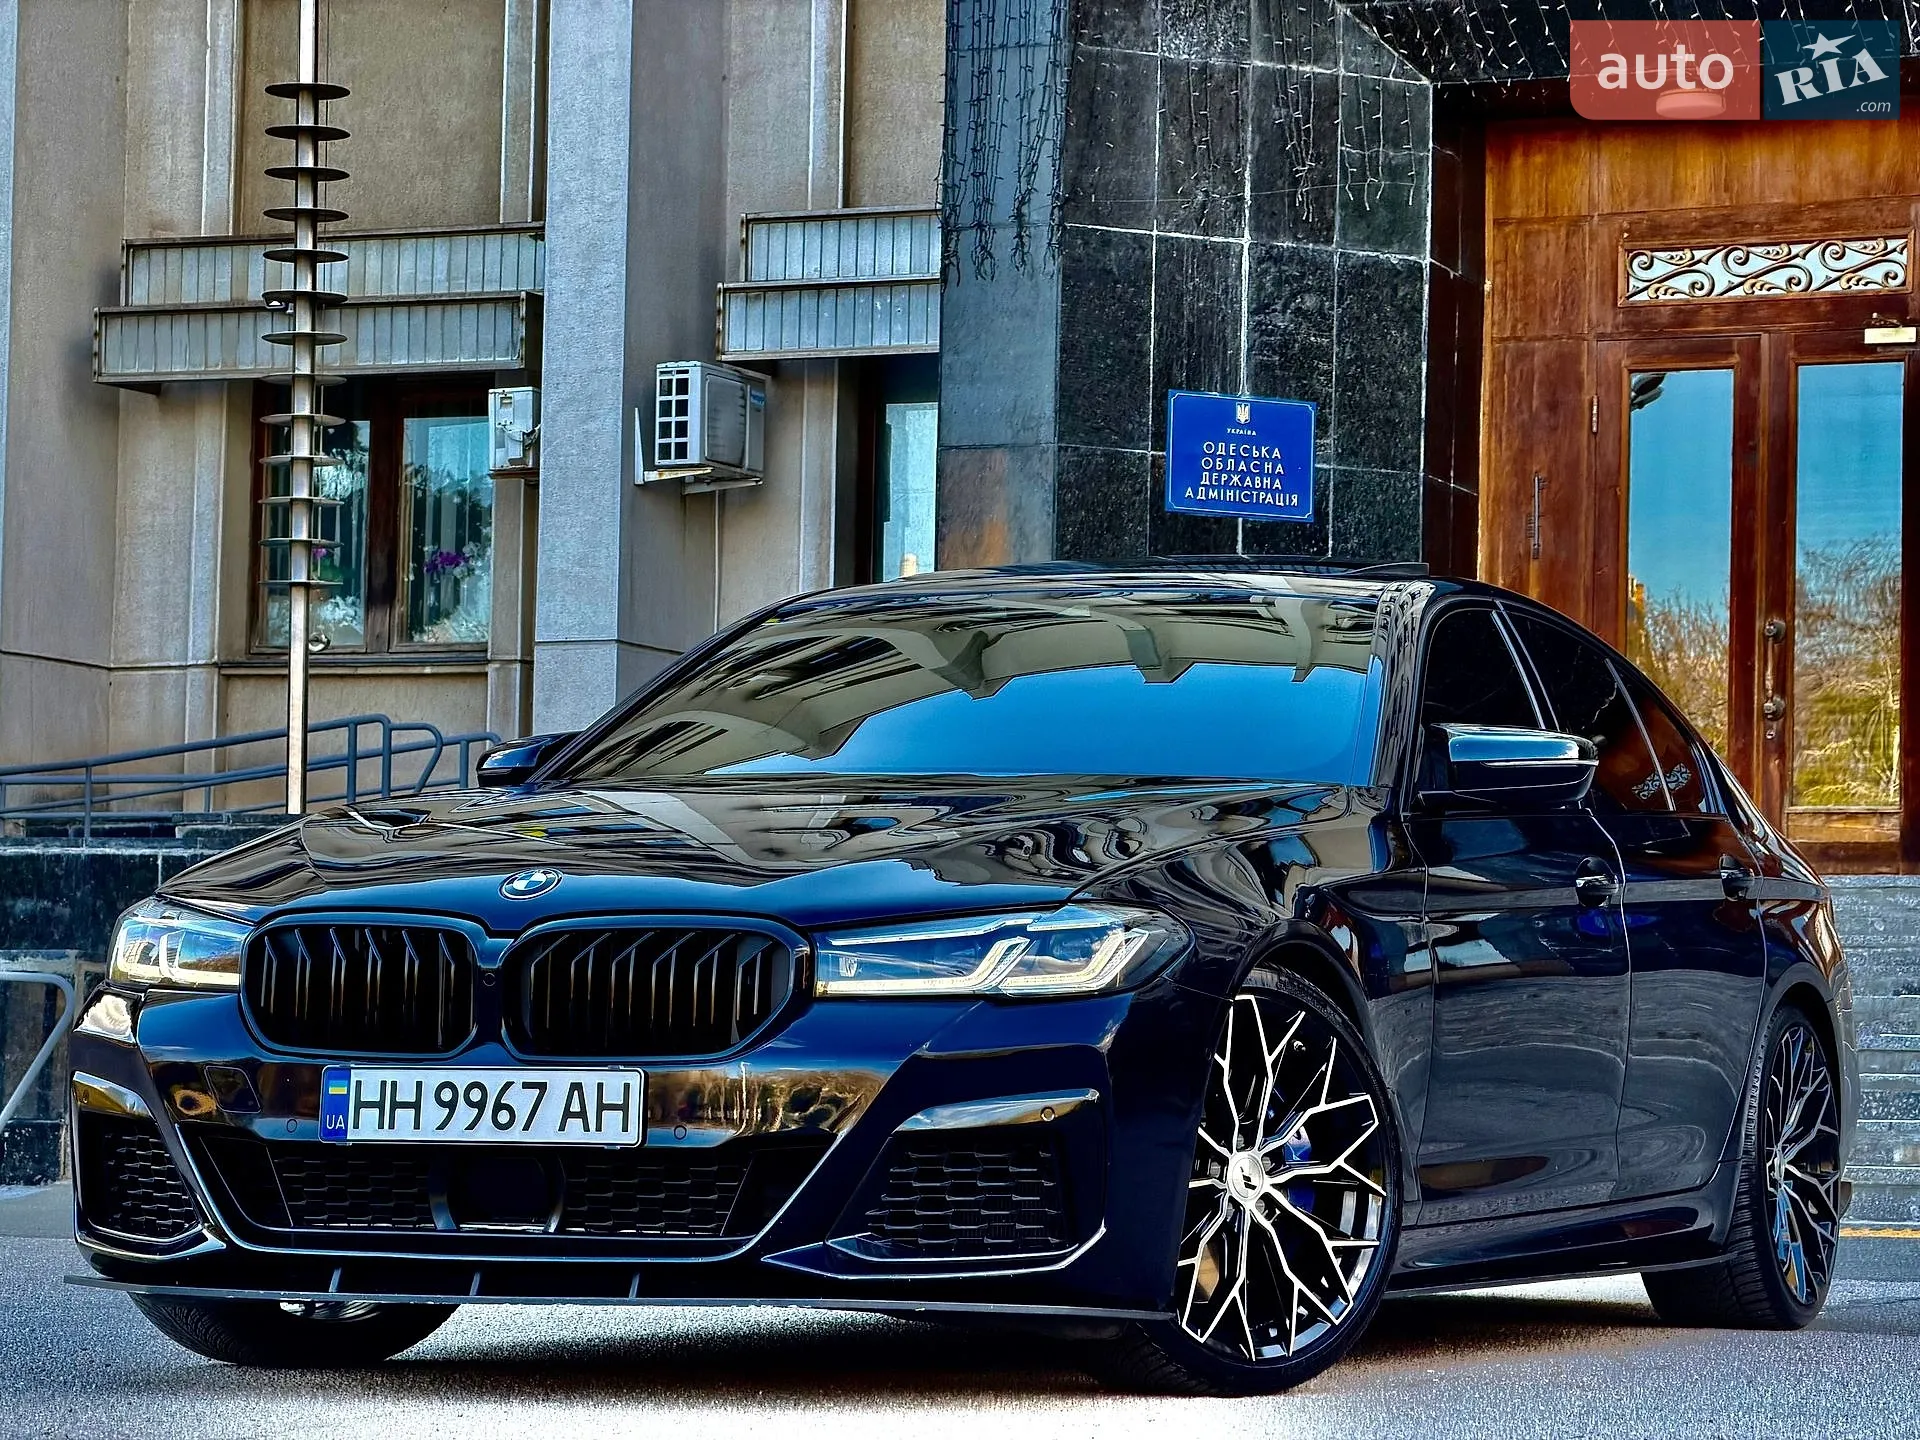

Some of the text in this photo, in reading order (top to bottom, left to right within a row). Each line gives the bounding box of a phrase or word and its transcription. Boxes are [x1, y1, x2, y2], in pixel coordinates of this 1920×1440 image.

[1203, 441, 1282, 459] ОДЕСЬКА
[1201, 457, 1284, 475] ОБЛАСНА
[1200, 472, 1282, 490] ДЕРЖАВНА
[1184, 487, 1298, 507] АДМІНІСТРАЦІЯ
[352, 1080, 631, 1133] HH 9967 AH
[326, 1114, 345, 1130] UA
